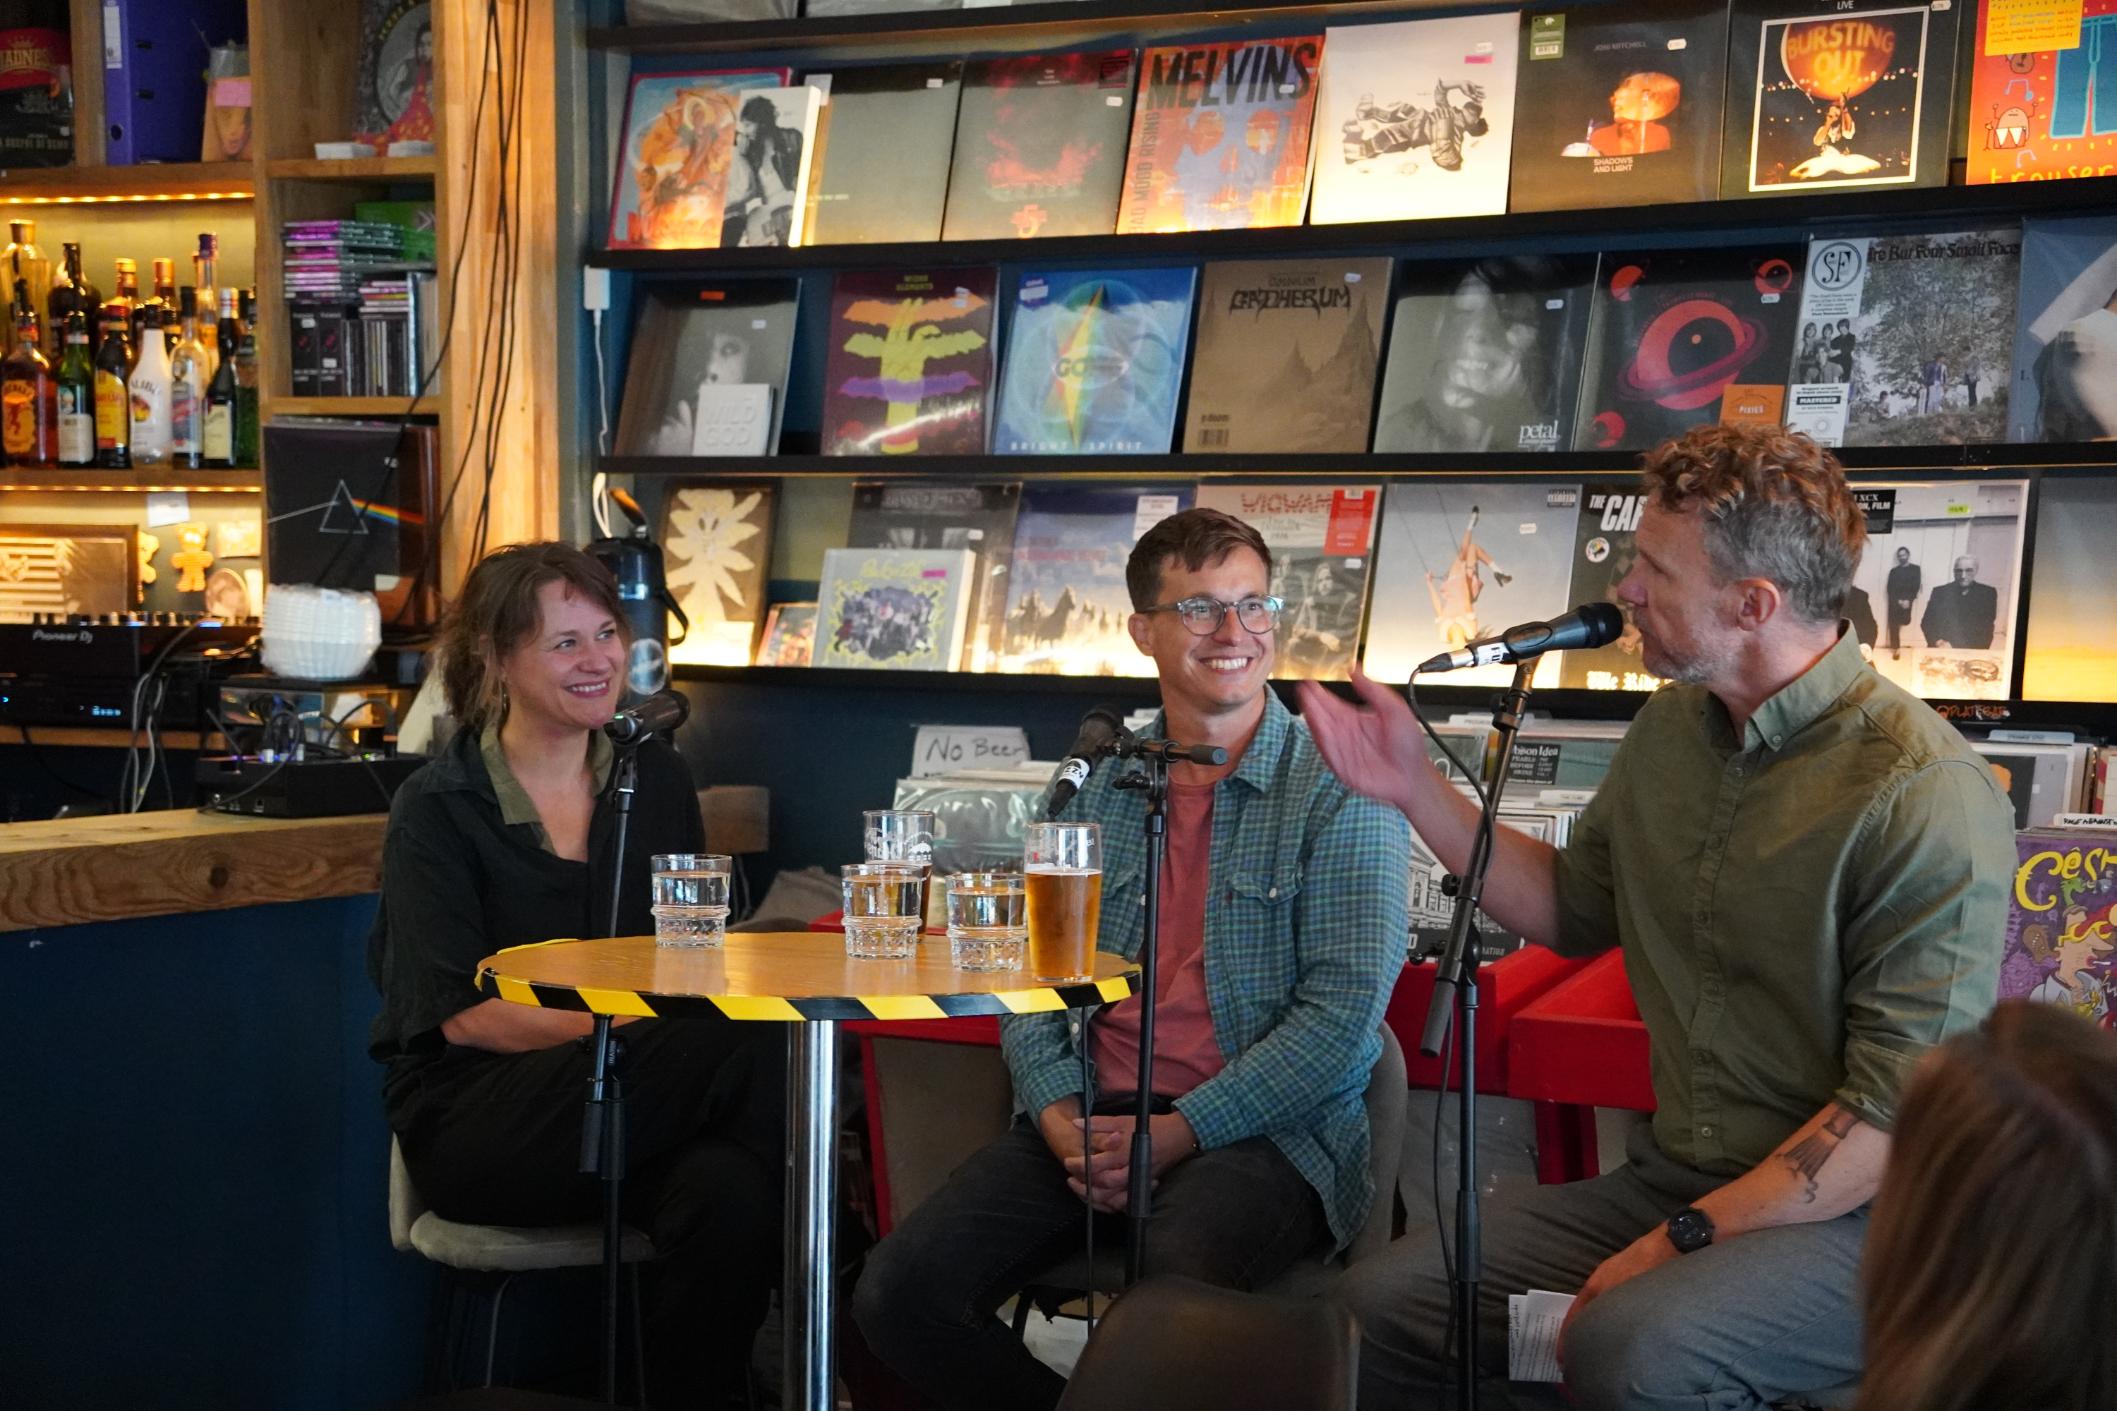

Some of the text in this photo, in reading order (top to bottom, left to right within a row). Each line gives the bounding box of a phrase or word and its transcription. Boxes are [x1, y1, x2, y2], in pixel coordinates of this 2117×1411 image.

[1836, 1, 1855, 10] LIVE
[1788, 22, 1897, 58] BURSTING
[1813, 49, 1866, 78] OUT
[1146, 42, 1317, 109] MELVINS
[1593, 156, 1634, 166] SHADOWS
[1593, 163, 1634, 174] AND LIGHT
[1010, 441, 1143, 451] BRIGHT SPIRIT
[1588, 494, 1607, 509] THE
[1871, 501, 1891, 510] FILM
[32, 629, 78, 641] Pioneer
[926, 737, 1027, 762] No Beer
